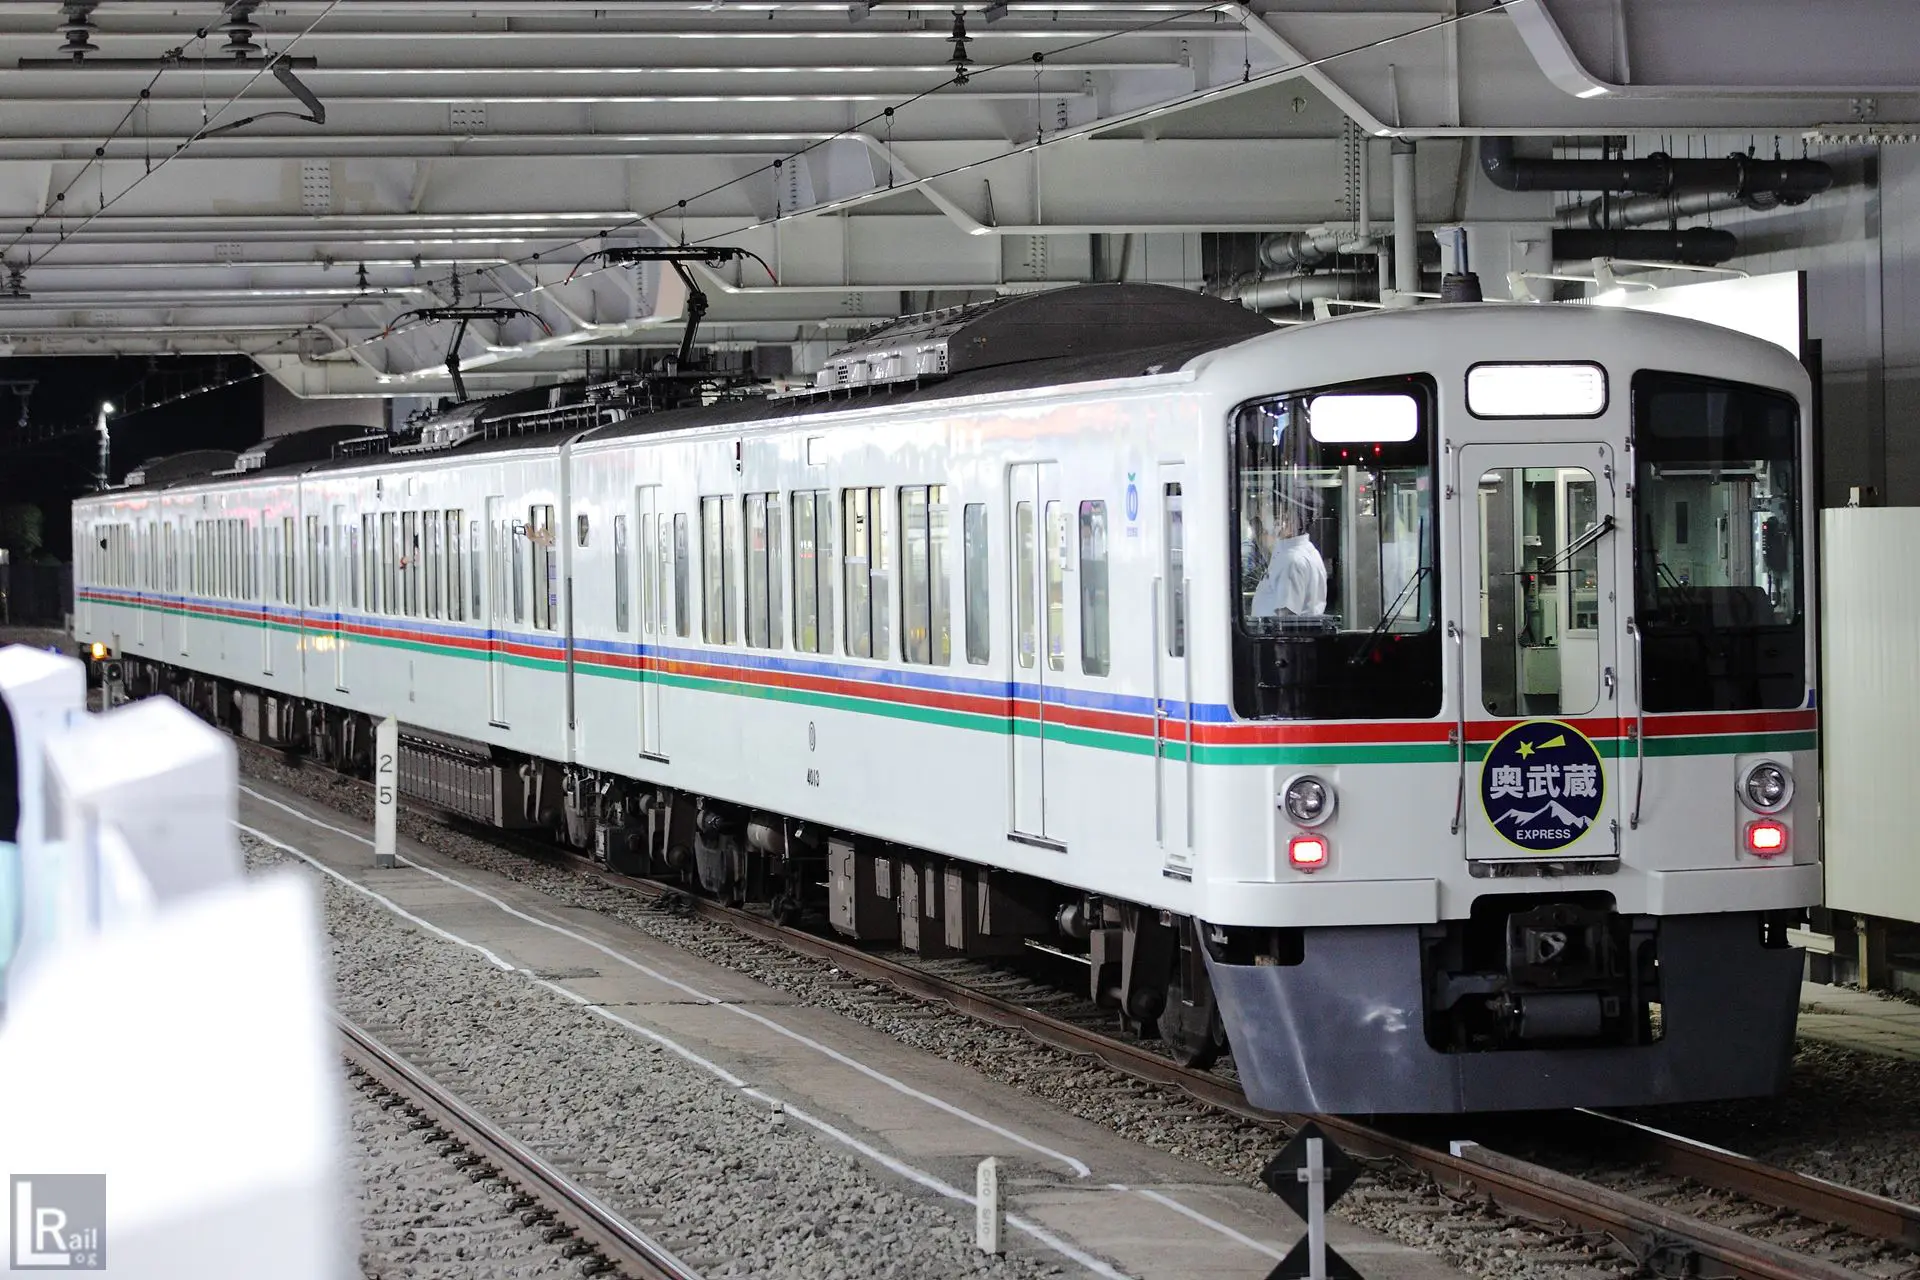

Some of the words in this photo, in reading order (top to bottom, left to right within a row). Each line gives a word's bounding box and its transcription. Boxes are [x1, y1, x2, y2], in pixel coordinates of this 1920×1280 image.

[807, 768, 820, 788] 4013
[1489, 763, 1597, 800] 奥武蔵
[1516, 829, 1571, 840] EXPRESS
